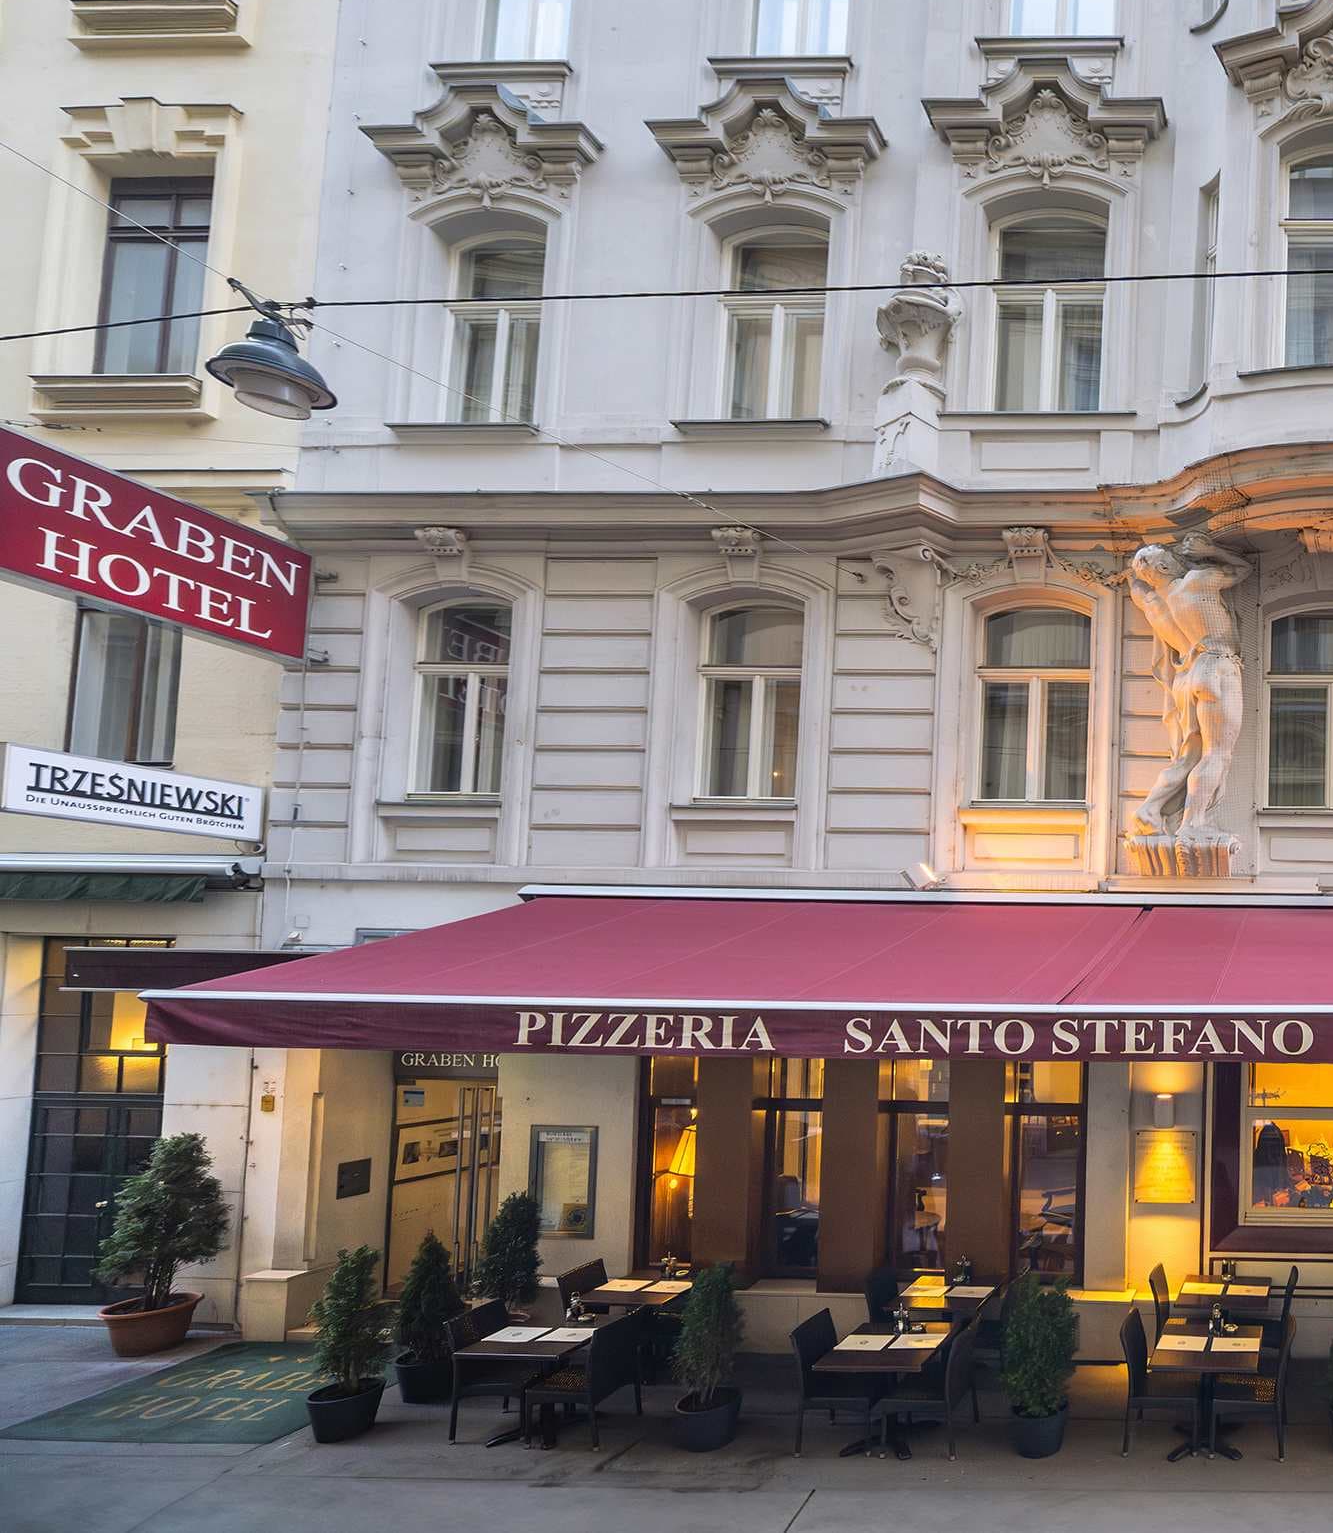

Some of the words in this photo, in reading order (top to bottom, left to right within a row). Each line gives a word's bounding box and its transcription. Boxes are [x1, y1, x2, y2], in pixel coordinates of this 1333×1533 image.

[6, 457, 302, 596] GRABEN
[36, 526, 272, 639] HOTEL
[27, 762, 244, 820] TRZEŚNIEWSKI
[401, 1052, 475, 1067] GRABEN
[512, 1011, 776, 1051] PIZZERIA
[843, 1017, 1035, 1054] SANTO
[1051, 1018, 1315, 1055] STEFANO
